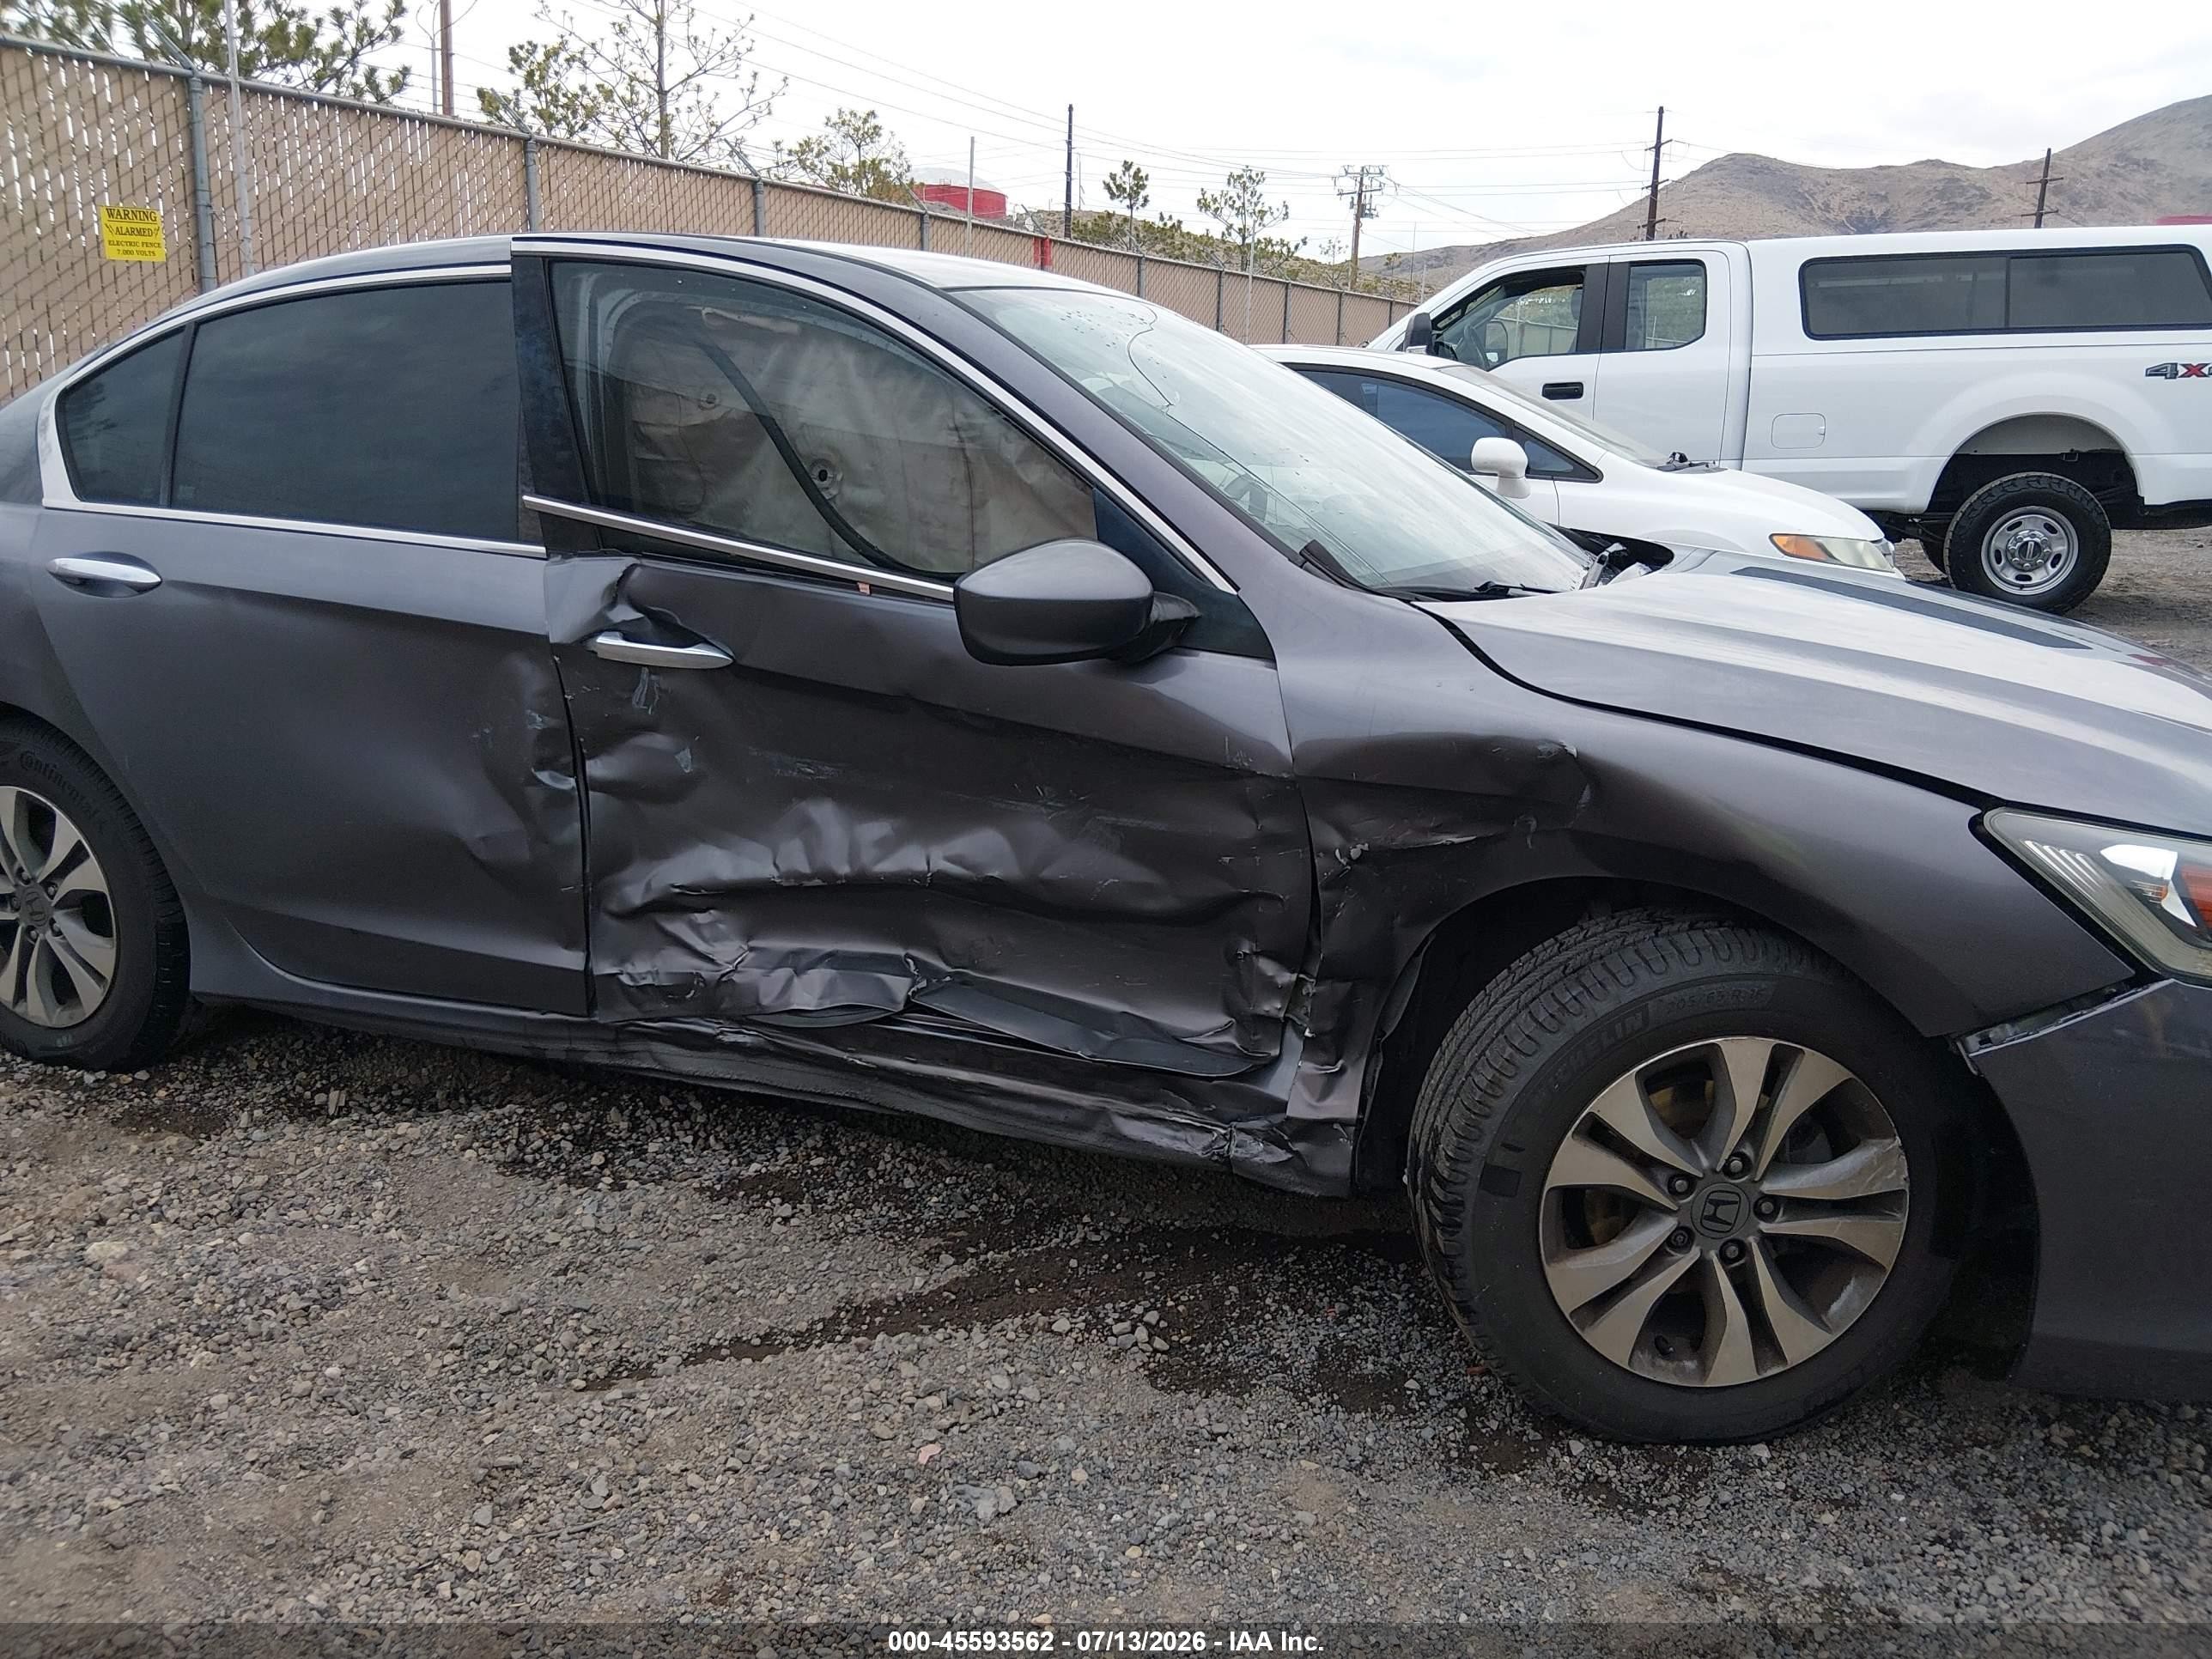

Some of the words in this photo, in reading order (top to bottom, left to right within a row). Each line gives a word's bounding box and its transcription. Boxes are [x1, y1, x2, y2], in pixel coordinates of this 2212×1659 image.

[106, 208, 157, 222] WARNING
[114, 226, 153, 237] ALARMED
[108, 240, 140, 248] ELECTRIC
[2145, 362, 2212, 380] 4X
